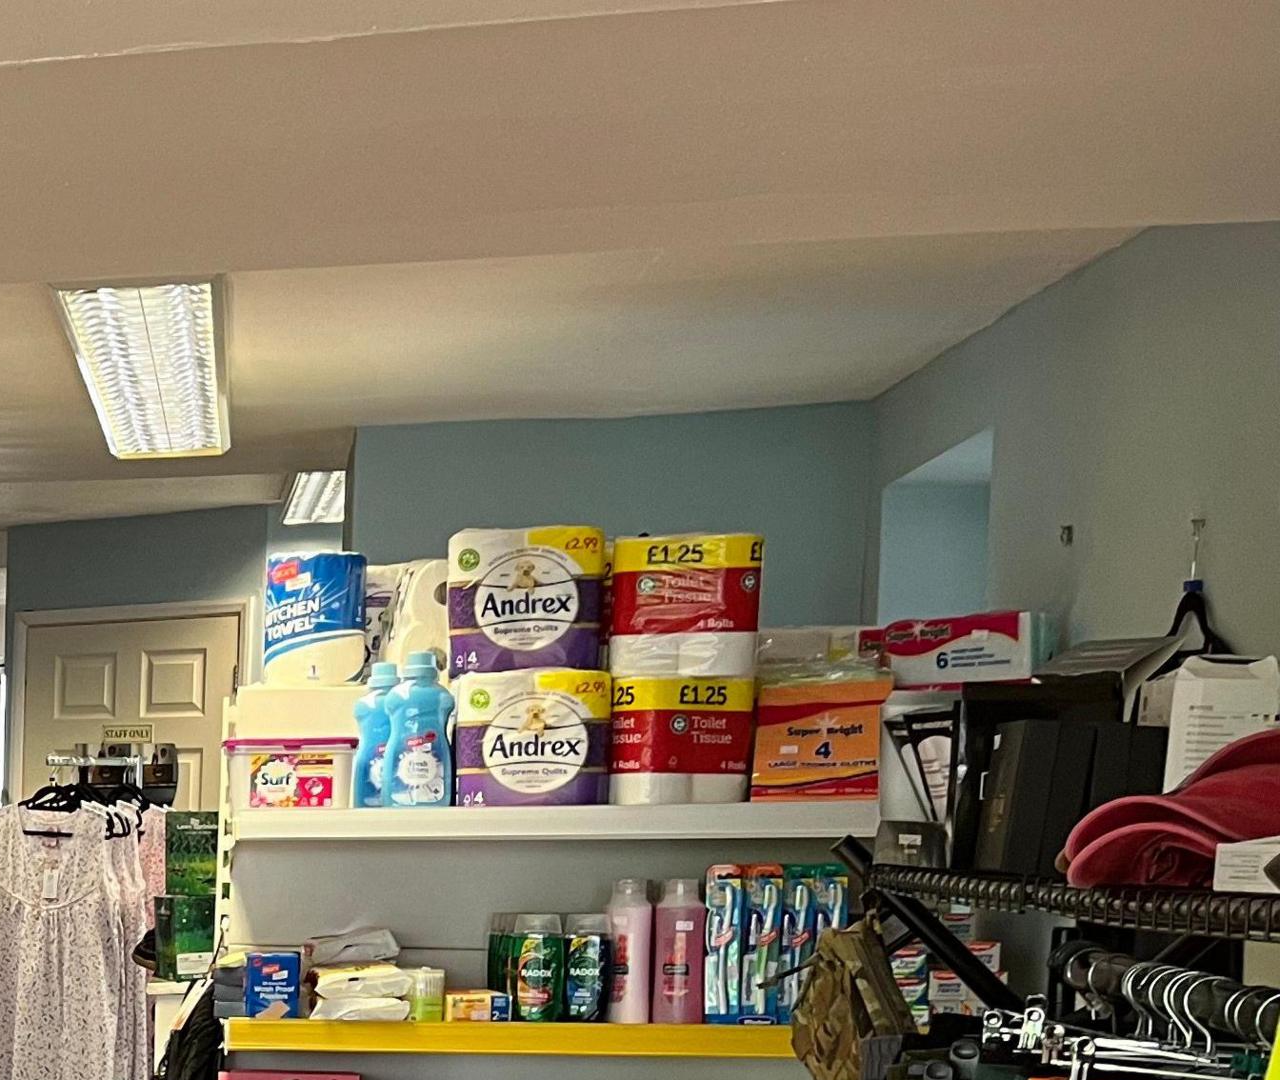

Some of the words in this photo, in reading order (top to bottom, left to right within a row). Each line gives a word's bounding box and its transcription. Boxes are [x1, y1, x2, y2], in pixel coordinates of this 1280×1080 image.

[565, 537, 598, 550] £2.99
[647, 543, 704, 565] £1.25
[481, 591, 572, 618] Andrex
[493, 626, 531, 635] Supreme
[533, 625, 559, 634] Quilts
[467, 651, 478, 663] 4
[936, 652, 949, 669] 6
[575, 681, 606, 694] £2.99
[679, 685, 728, 706] £1.25
[691, 716, 727, 729] Toilet
[105, 729, 128, 738] STAFF
[129, 729, 149, 739] ONLY
[786, 727, 822, 738] Super
[826, 724, 863, 737] Bright
[691, 731, 733, 745] Tissue
[489, 734, 582, 759] Andrex
[815, 741, 832, 759] 4
[501, 767, 540, 777] Supreme
[541, 767, 568, 776] Quilts
[261, 773, 293, 786] Surf
[473, 791, 484, 802] 4
[520, 968, 552, 978] RADOX
[569, 967, 600, 977] RADOX
